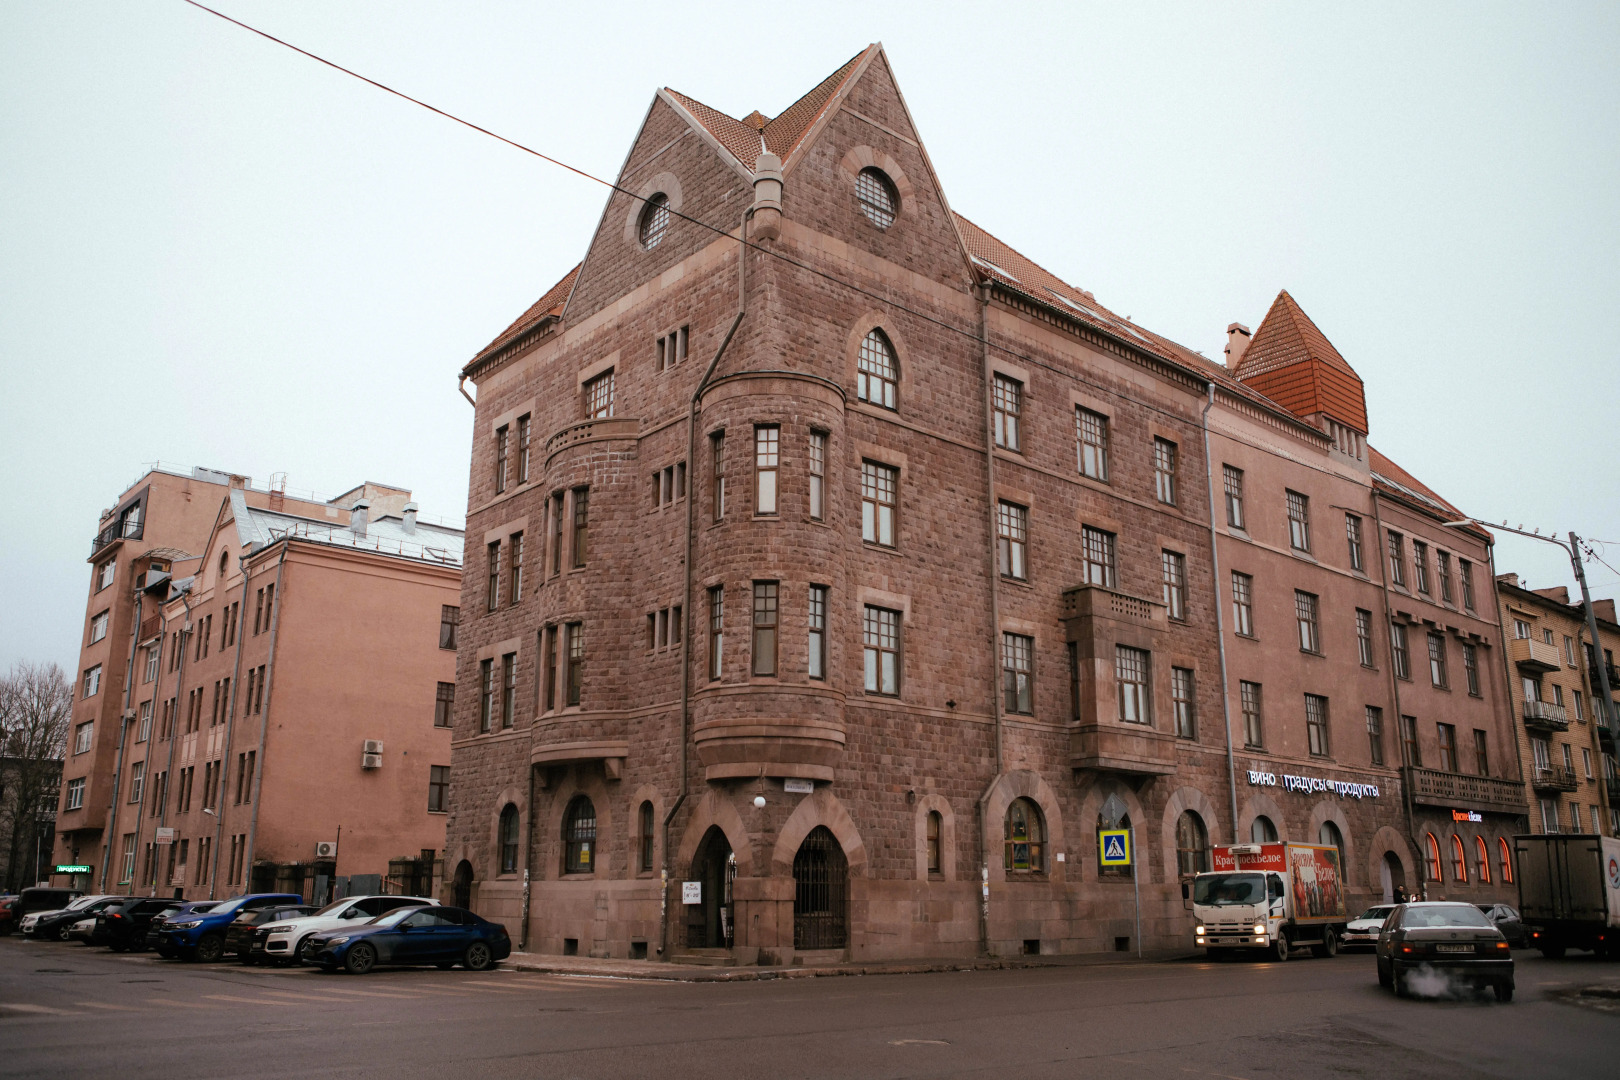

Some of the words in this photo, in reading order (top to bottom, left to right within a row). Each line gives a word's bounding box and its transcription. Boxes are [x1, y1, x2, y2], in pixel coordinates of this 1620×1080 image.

[1247, 770, 1276, 786] вино
[1281, 774, 1327, 794] градусы
[1333, 780, 1380, 799] продукты
